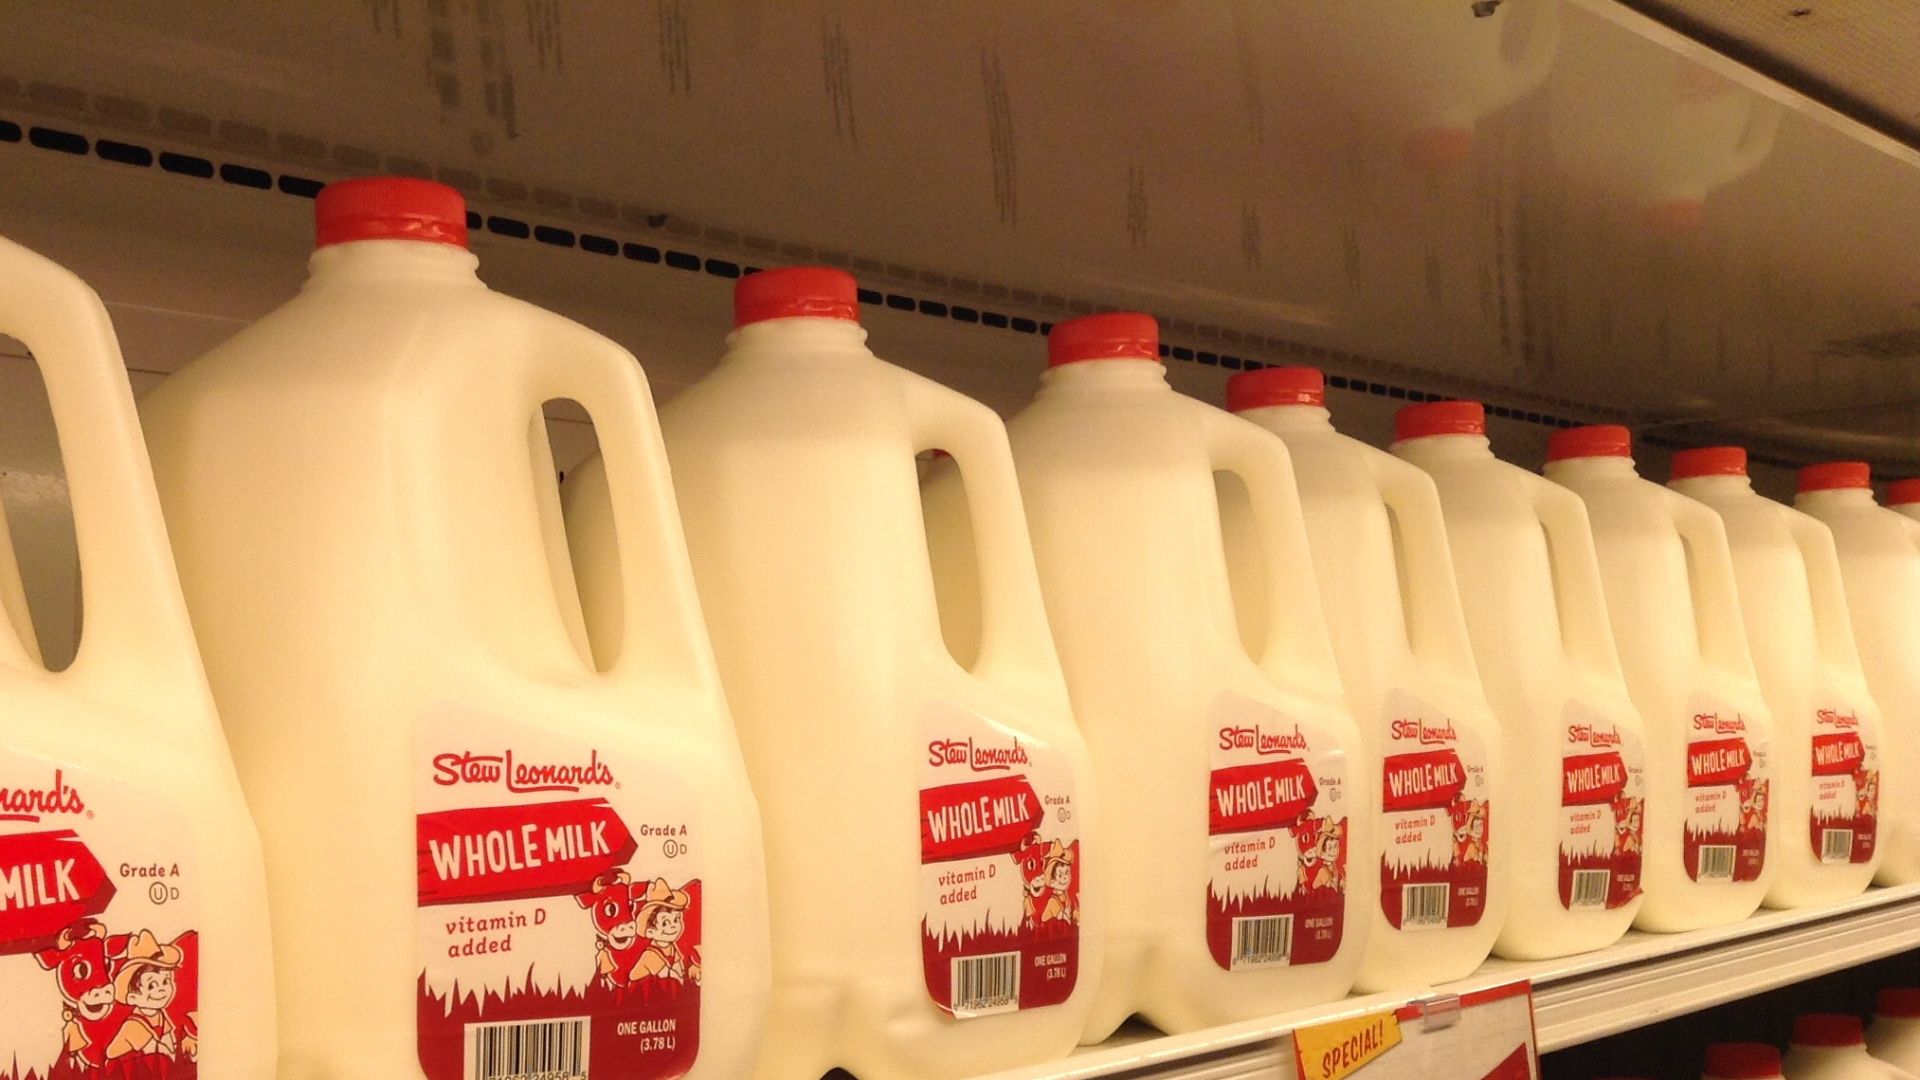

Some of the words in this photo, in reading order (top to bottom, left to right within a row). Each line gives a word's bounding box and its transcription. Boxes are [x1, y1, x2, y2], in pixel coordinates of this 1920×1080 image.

[1219, 725, 1254, 750] Stew
[929, 738, 968, 767] Stew
[969, 736, 1027, 772] Leonard's
[1691, 748, 1726, 776] WHOLE
[433, 751, 503, 786] Stew
[506, 750, 614, 793] Leonard's
[1389, 763, 1432, 798] WHOLE
[1434, 763, 1458, 786] MILK
[1567, 764, 1601, 794] WHOLE
[1601, 763, 1621, 786] MILK
[1216, 776, 1274, 818] WHOLE
[1275, 775, 1306, 804] MILK
[640, 824, 676, 836] Grade
[679, 824, 687, 836] A
[928, 796, 989, 843] WHOLE
[993, 793, 1030, 824] MILK
[429, 823, 541, 881] WHOLE
[545, 820, 611, 862] MILK
[1224, 840, 1266, 855] vitamin
[1269, 836, 1276, 850] D
[120, 863, 165, 878] Grade
[170, 863, 180, 877] A
[938, 868, 986, 886] vitamin
[988, 864, 996, 878] D
[1225, 855, 1258, 871] added
[940, 886, 977, 905] added
[446, 912, 527, 935] vitamin
[534, 908, 547, 925] D
[448, 935, 512, 958] added
[617, 1021, 637, 1036] ONE
[640, 1019, 676, 1034] GALLON
[640, 1037, 665, 1053] (3.78
[1322, 1018, 1383, 1079] SPECIAL!
